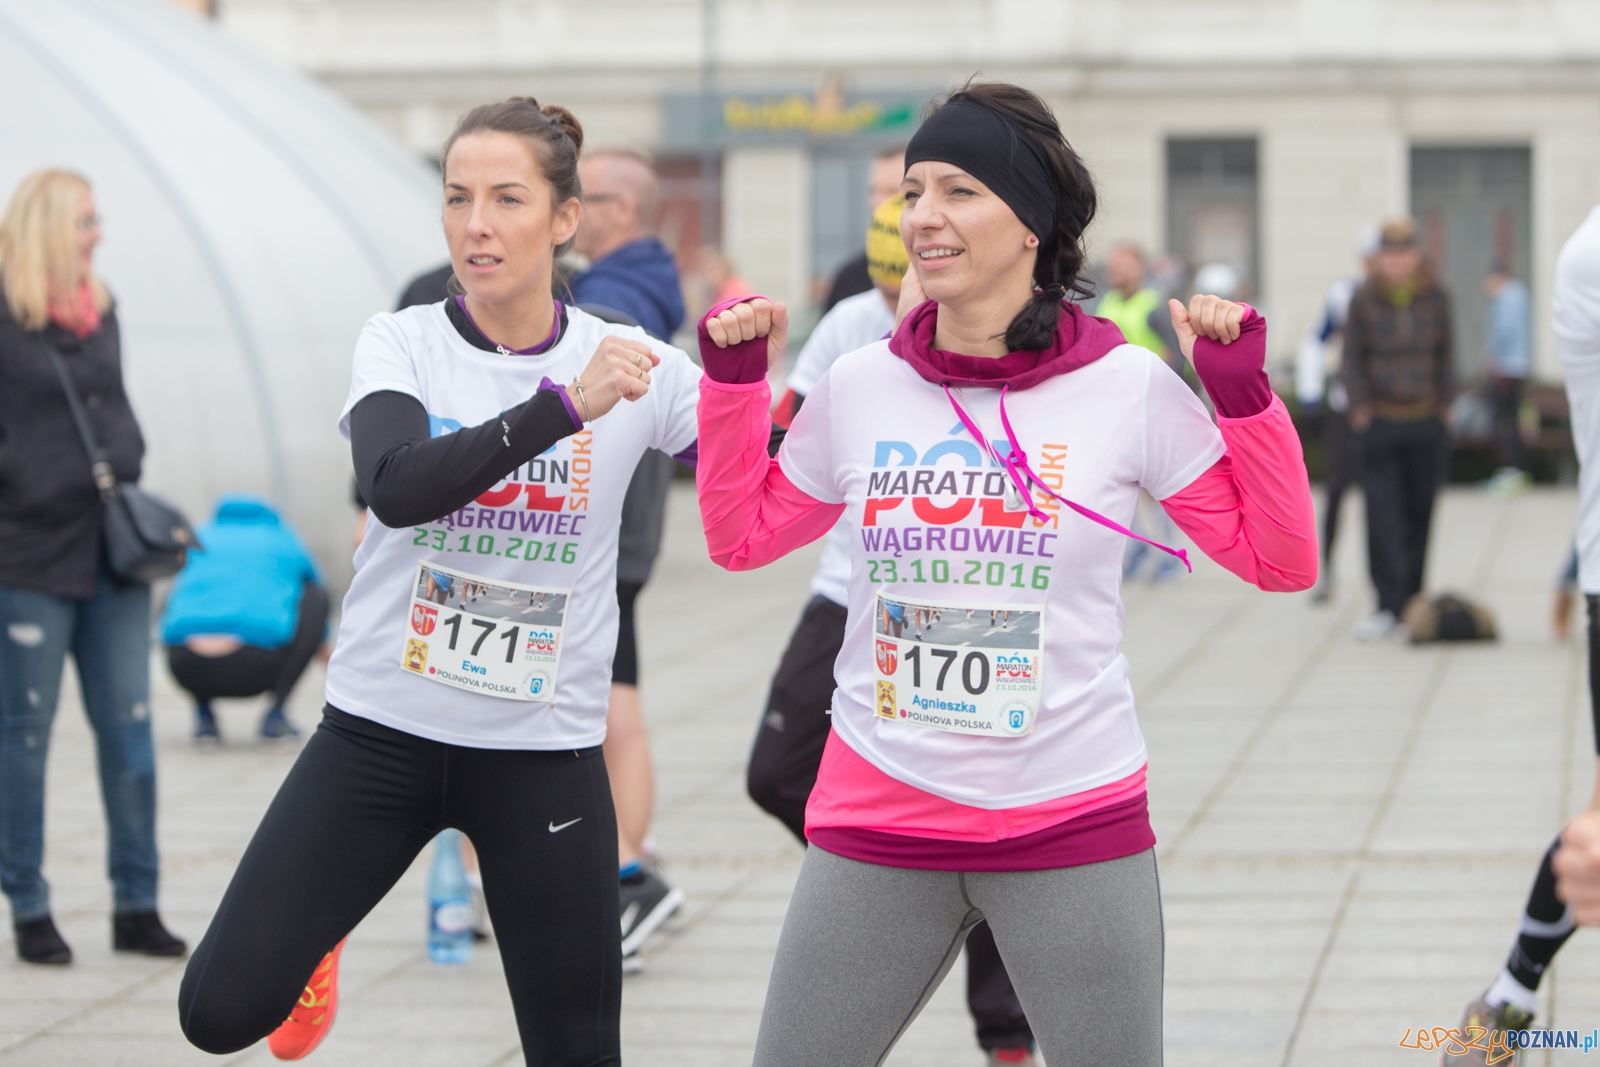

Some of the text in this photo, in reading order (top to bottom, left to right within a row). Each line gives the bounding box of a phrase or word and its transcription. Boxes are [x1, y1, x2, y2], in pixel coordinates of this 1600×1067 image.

[1032, 443, 1068, 529] SKOKI
[429, 506, 586, 536] ĄGROWIEC
[413, 527, 578, 564] 23.10.2016
[861, 527, 1057, 558] WĄGROWIEC
[867, 558, 1051, 590] 23.10.2016
[443, 613, 520, 664] 171
[437, 669, 480, 688] POLINOVA
[482, 682, 517, 694] POLSKA
[461, 660, 487, 675] Ewa
[904, 645, 990, 695] 170
[996, 663, 1032, 671] MARATON
[912, 694, 977, 714] Agnieszka
[908, 711, 952, 726] POLINOVA
[954, 720, 992, 730] POLSKA
